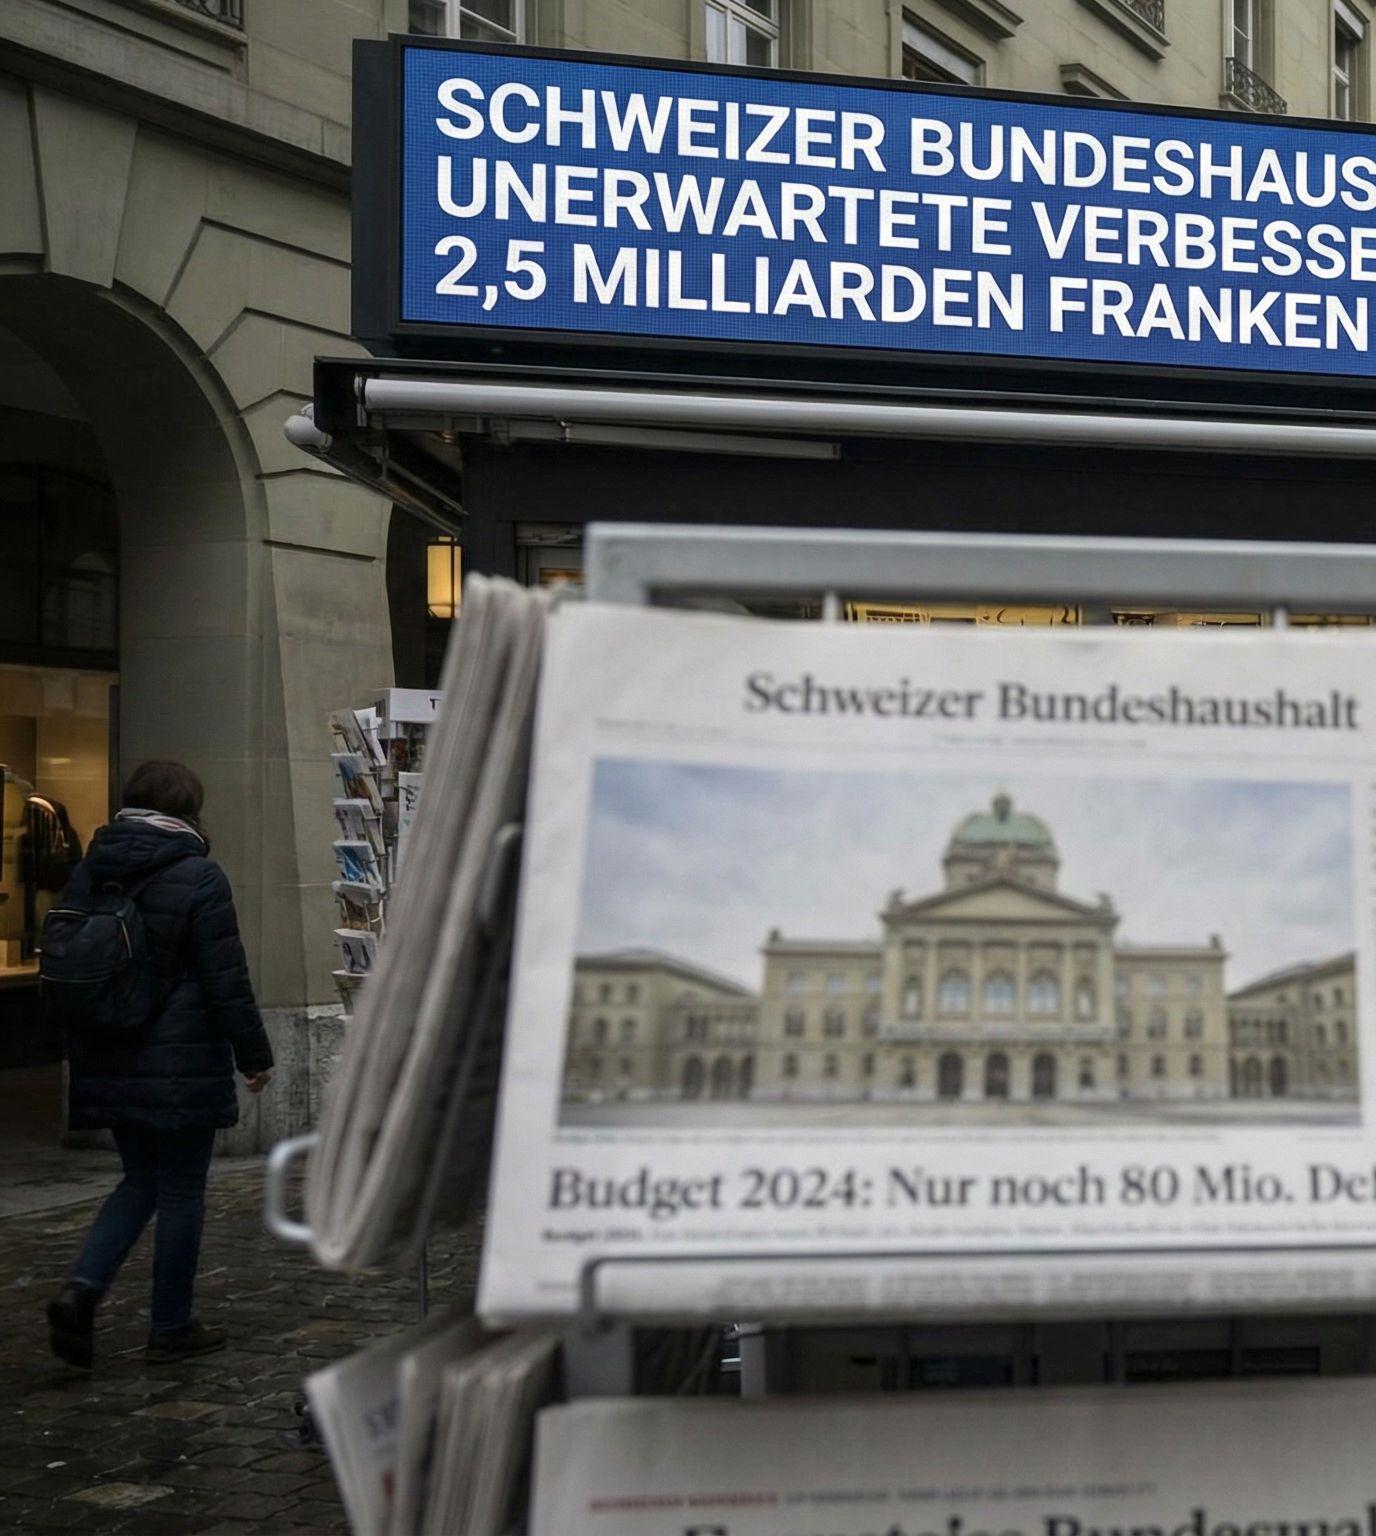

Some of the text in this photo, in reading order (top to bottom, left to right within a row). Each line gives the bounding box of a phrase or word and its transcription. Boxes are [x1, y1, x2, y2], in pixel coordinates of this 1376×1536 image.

[436, 78, 887, 173] SCHWEIZER
[438, 156, 1012, 256] UNERWARTETE
[435, 236, 1368, 352] 2,5 MILLIARDEN FRANKEN
[744, 671, 1358, 729] Schweizer Bundeshaushalt
[549, 1166, 722, 1221] Budget
[738, 1166, 875, 1210] 2024:
[886, 1166, 976, 1209] Nur
[989, 1164, 1104, 1207] noch
[1119, 1164, 1180, 1204] 80
[1193, 1162, 1294, 1203] Mio.
